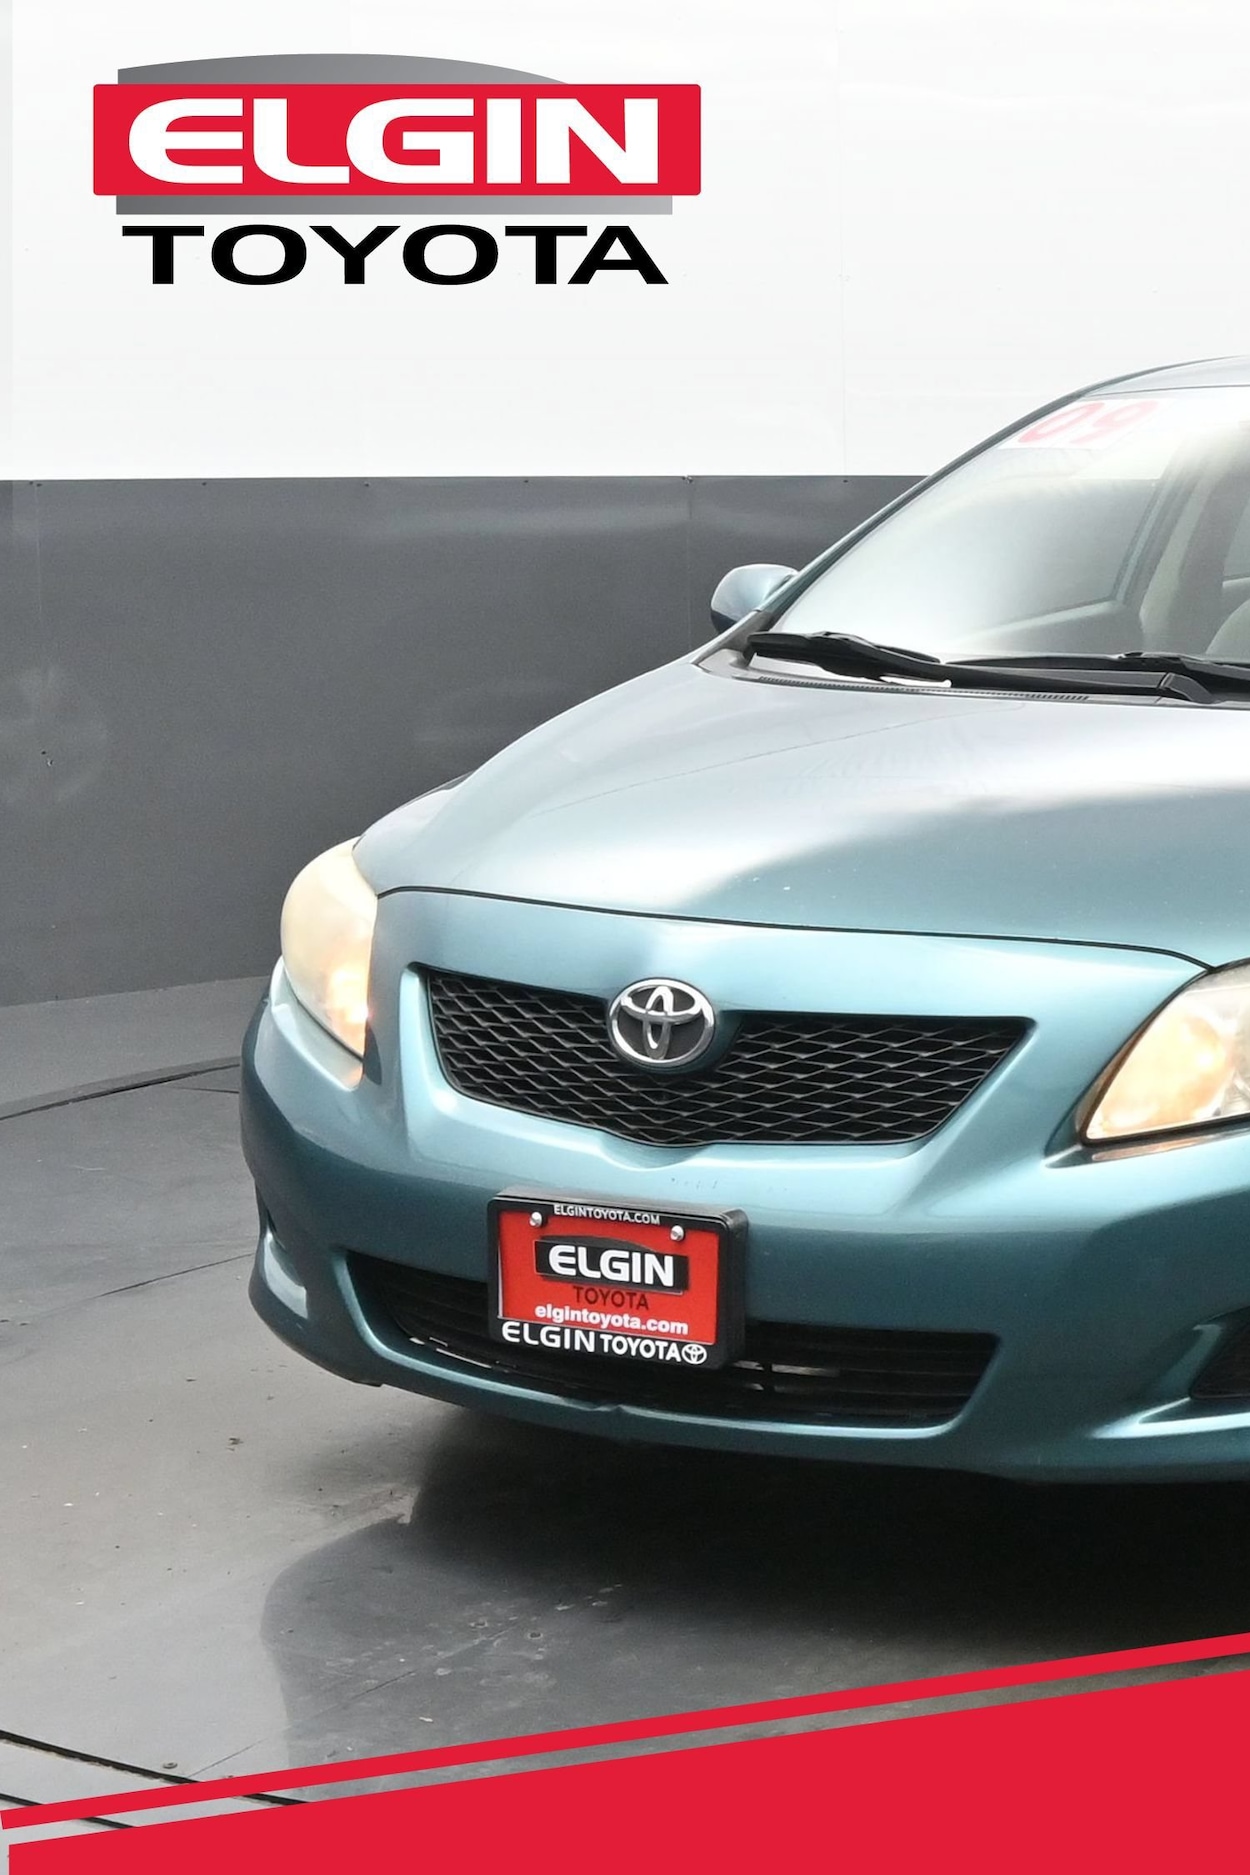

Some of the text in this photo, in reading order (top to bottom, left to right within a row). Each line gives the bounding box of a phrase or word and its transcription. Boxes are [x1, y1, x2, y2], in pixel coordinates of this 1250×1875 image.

[553, 1204, 660, 1225] ELGINTOYOTA.COM
[549, 1245, 673, 1287] ELGIN
[573, 1285, 649, 1310] TOYOTA
[535, 1304, 688, 1335] elgintoyota.com
[502, 1321, 681, 1362] ELGIN TOYOTA
